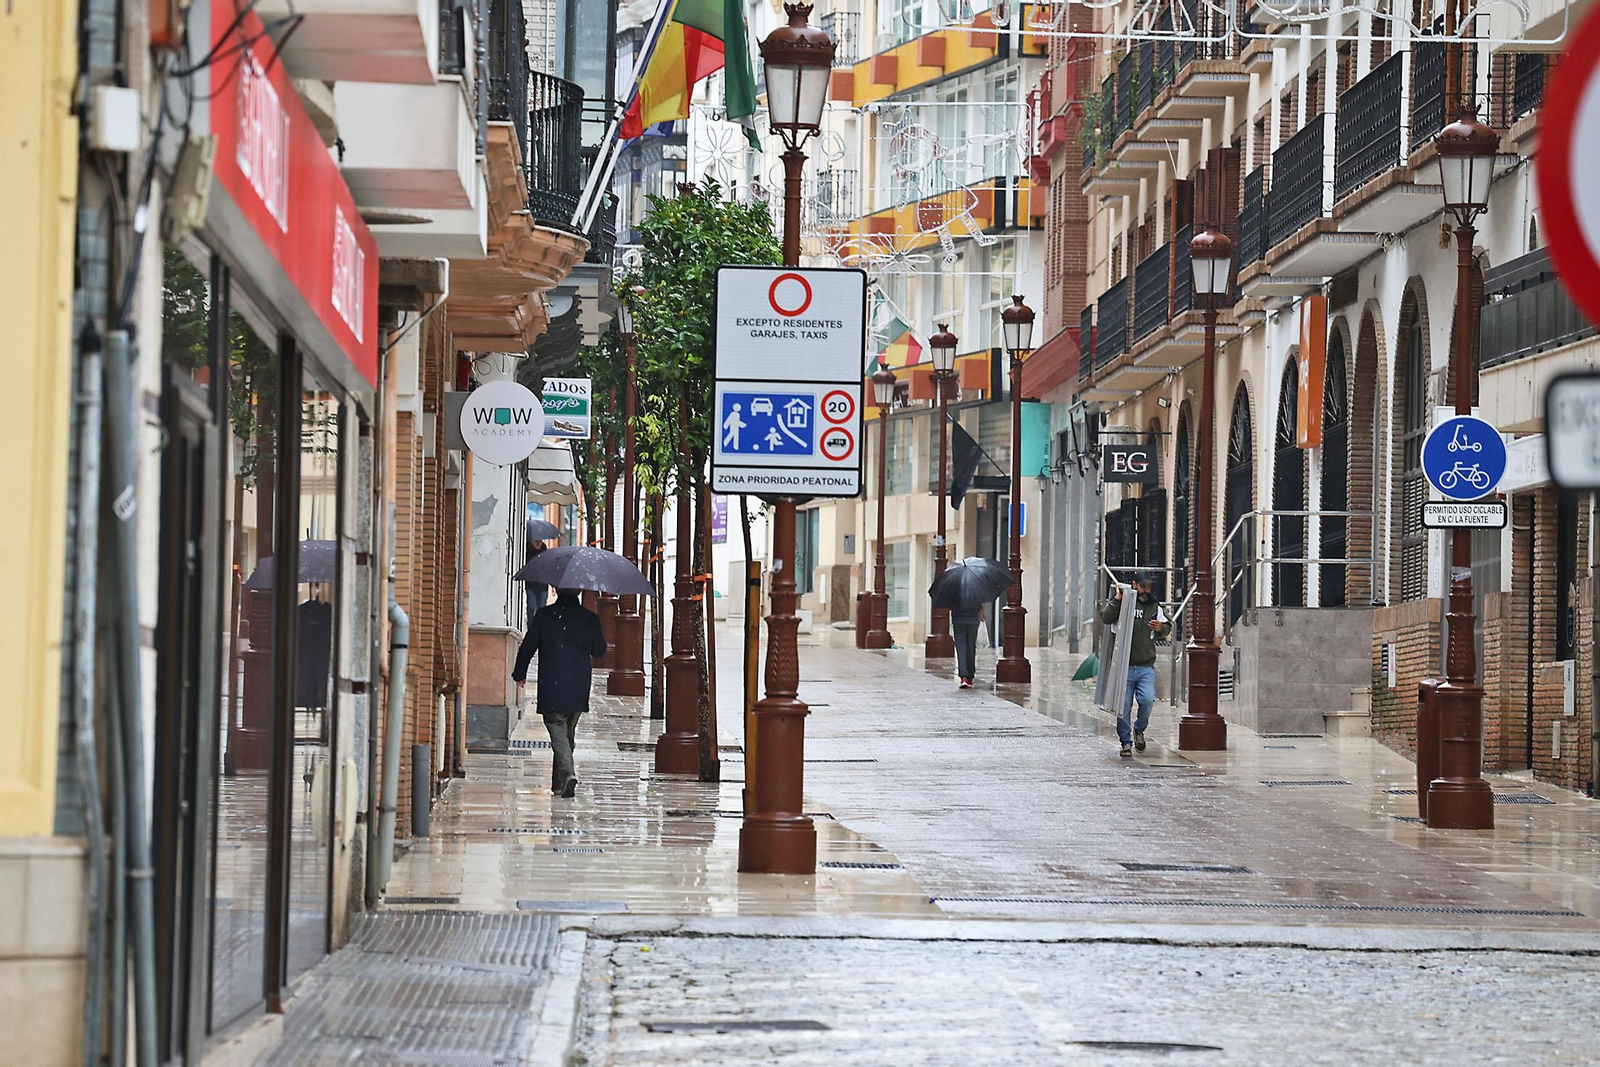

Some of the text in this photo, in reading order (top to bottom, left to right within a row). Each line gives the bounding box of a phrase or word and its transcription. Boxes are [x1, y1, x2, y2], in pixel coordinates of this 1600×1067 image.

[736, 318, 843, 329] EXCEPTO RESIDENTES
[750, 329, 828, 340] GARAJES, TAXIS
[828, 402, 847, 414] 20
[472, 428, 533, 436] ACADEMY
[1111, 451, 1149, 473] EG
[718, 474, 854, 487] ZONA PRIORIDAD PEATONAL
[1425, 505, 1503, 515] PERMITIDO USO CICLABLE
[1437, 516, 1446, 524] EN
[1455, 516, 1463, 524] LA
[1464, 516, 1489, 524] FUENTE
